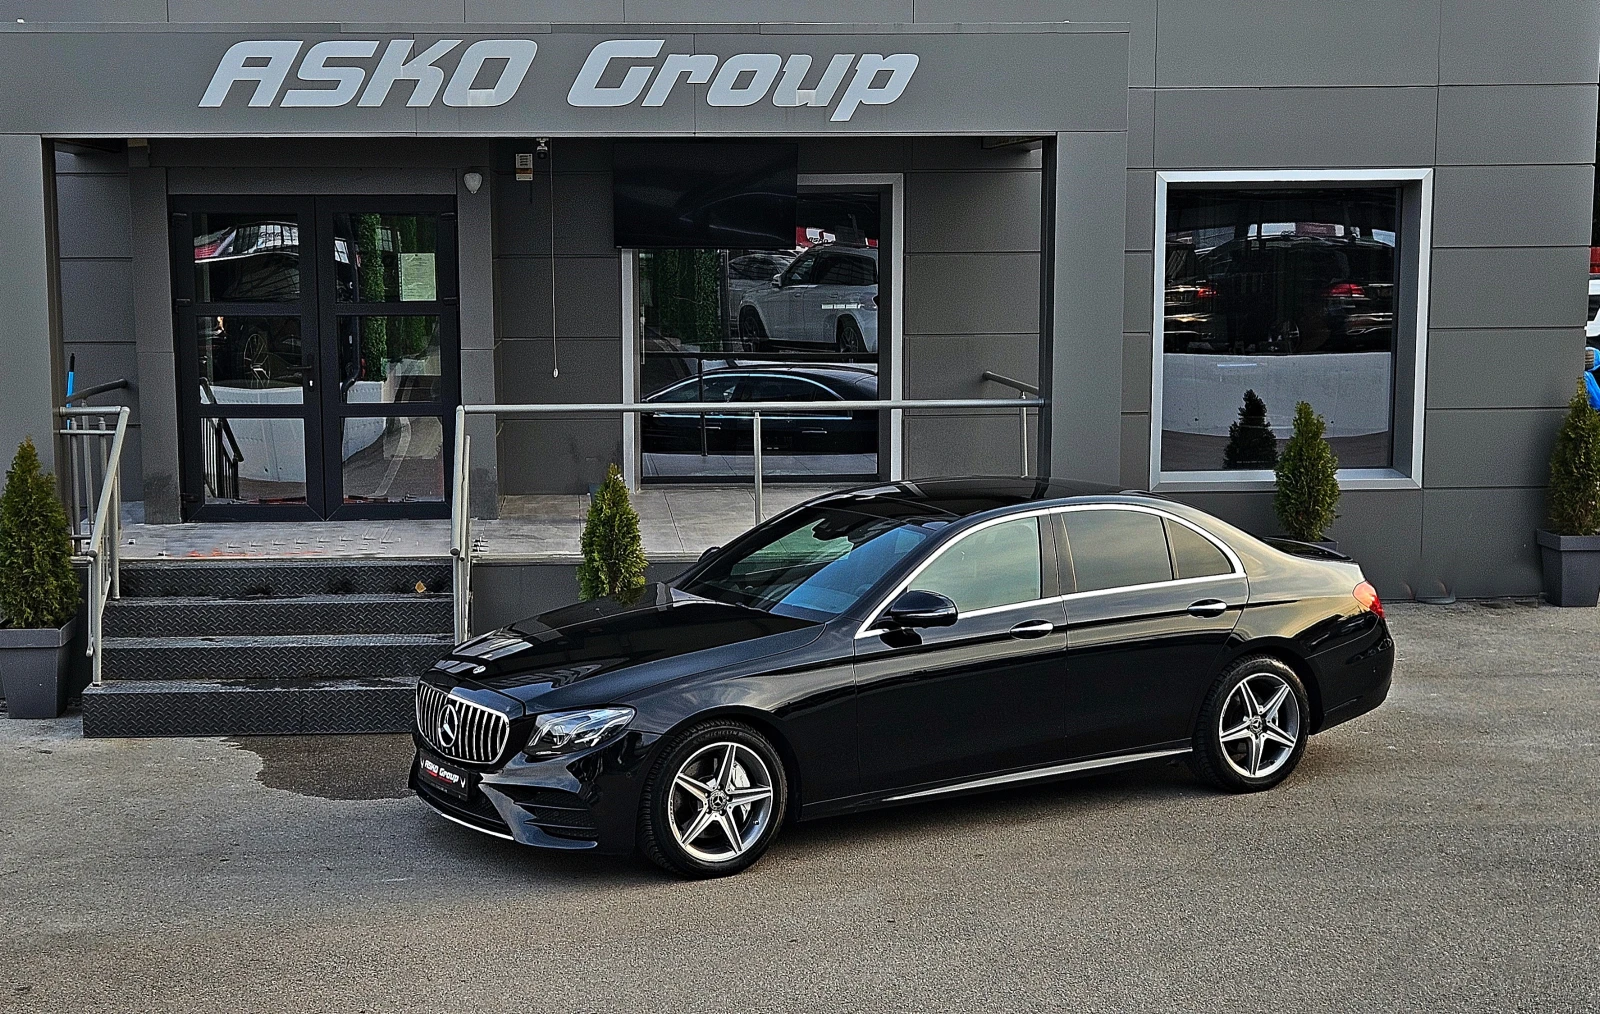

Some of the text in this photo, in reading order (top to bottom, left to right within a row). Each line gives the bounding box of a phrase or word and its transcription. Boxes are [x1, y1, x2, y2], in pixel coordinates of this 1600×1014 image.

[198, 39, 920, 122] ASKO Group
[424, 759, 460, 783] ASKO Group
